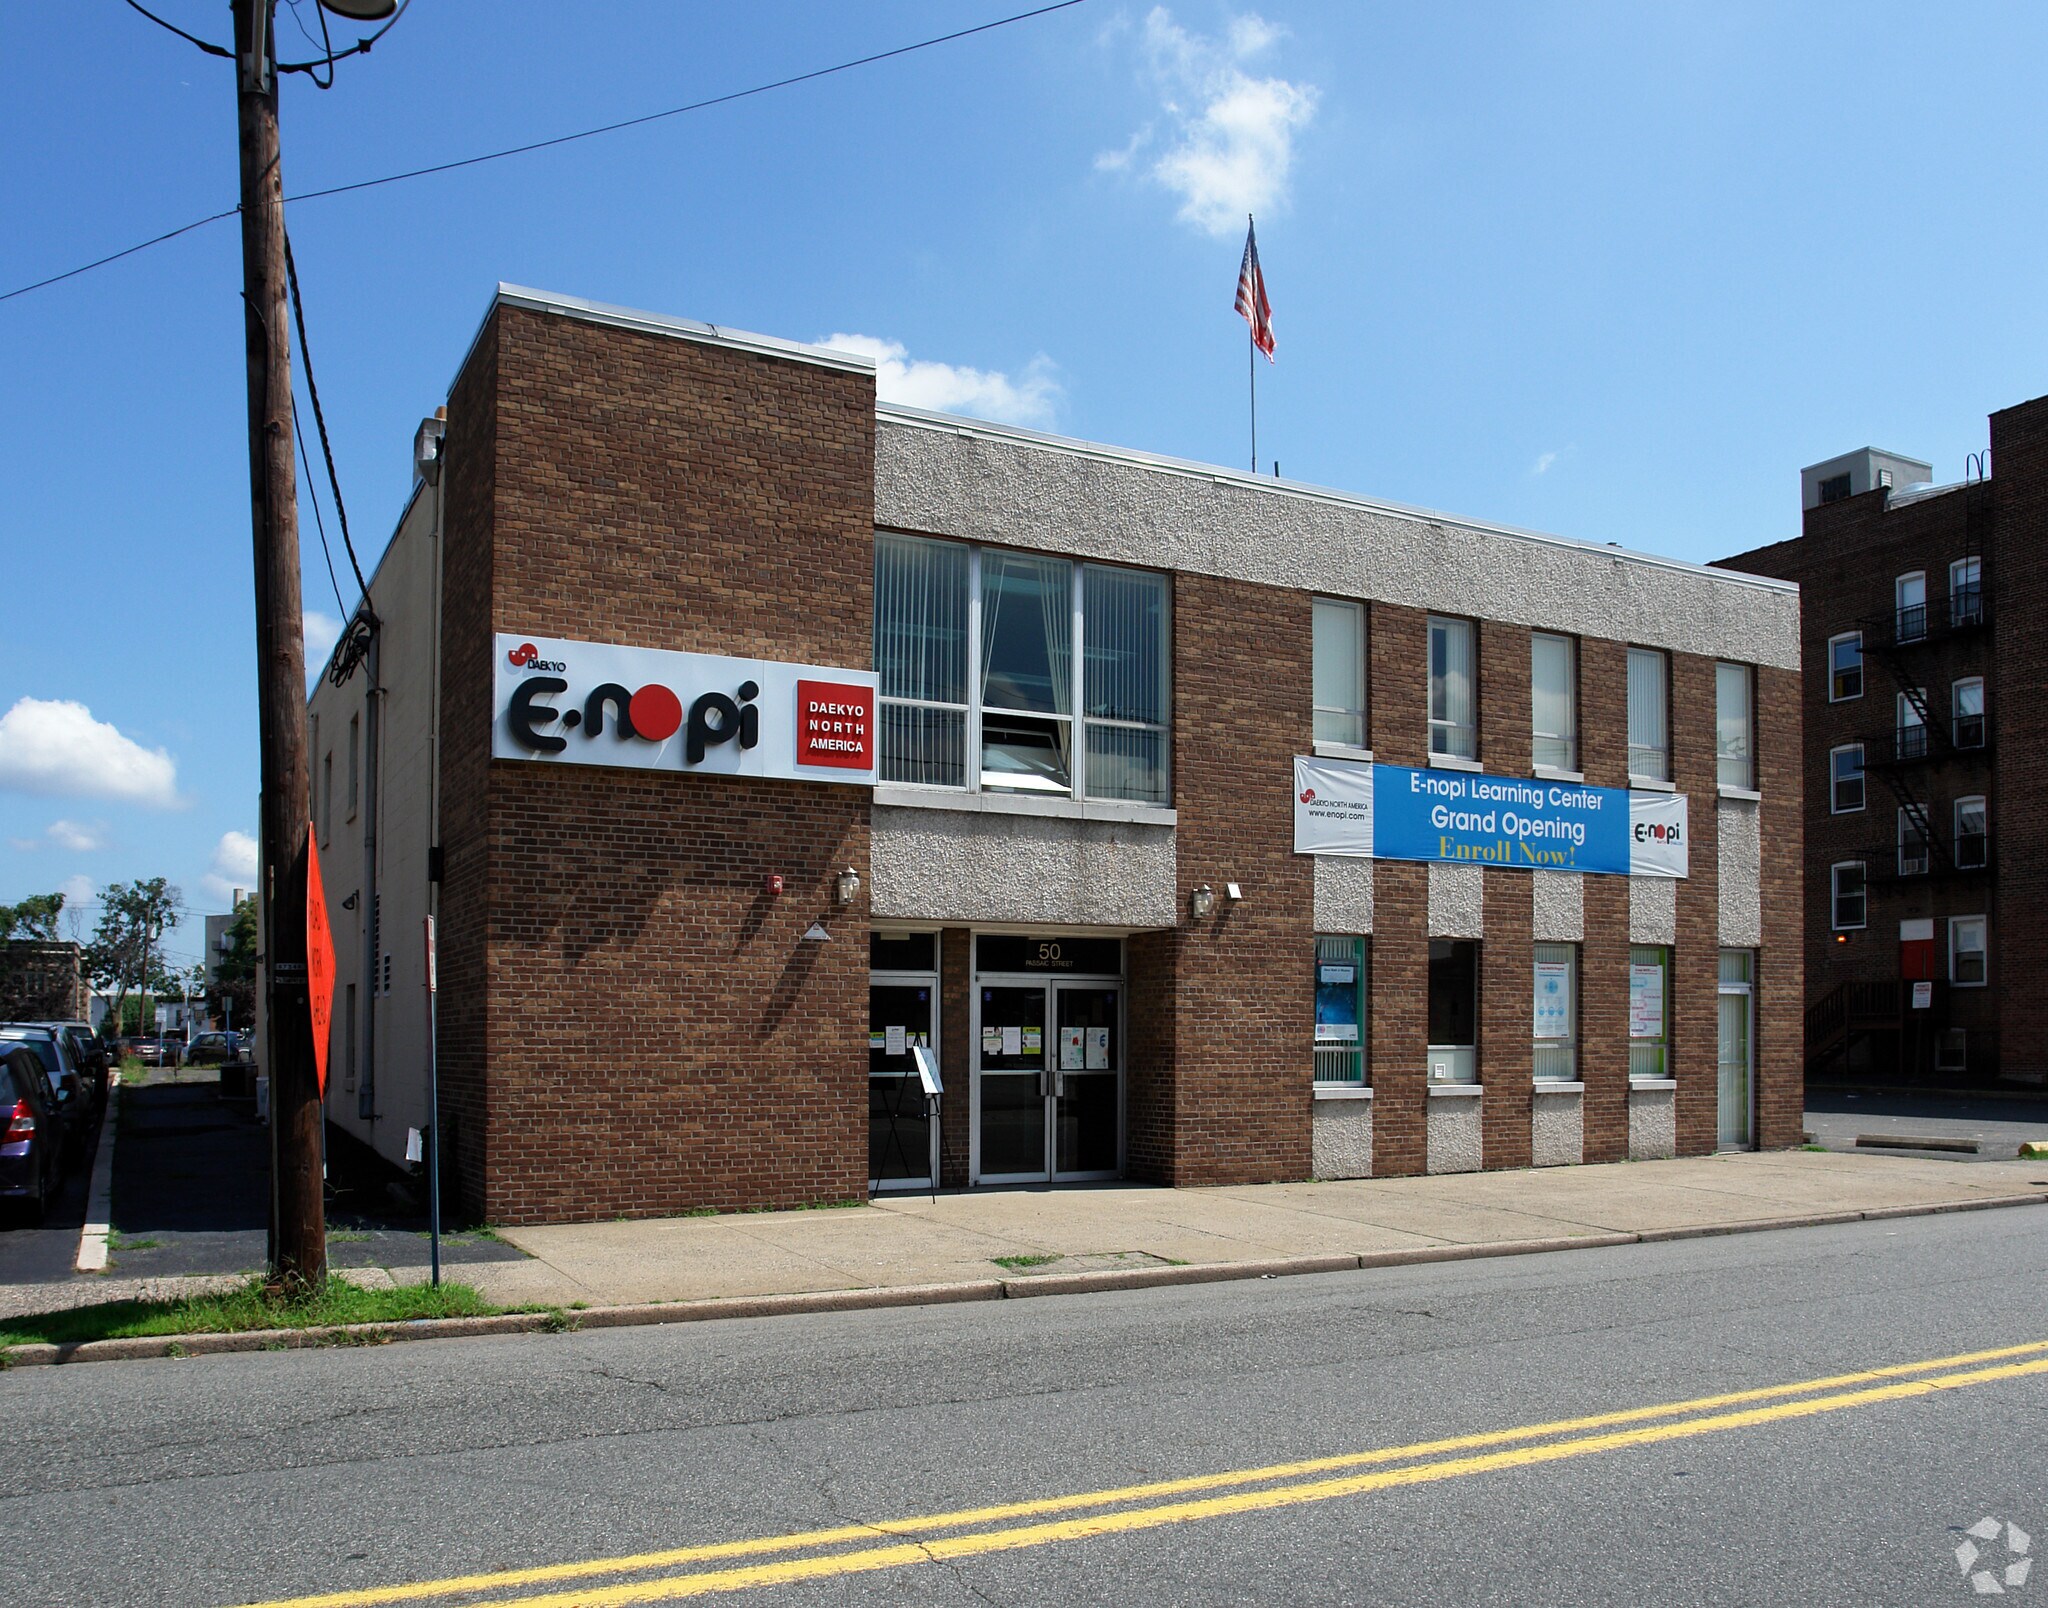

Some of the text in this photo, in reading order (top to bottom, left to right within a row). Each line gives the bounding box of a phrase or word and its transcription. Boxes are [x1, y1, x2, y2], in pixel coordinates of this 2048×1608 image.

[528, 659, 567, 672] DAEKYO
[809, 701, 865, 717] DAEKYO
[809, 719, 865, 735] NORTH
[809, 738, 864, 753] AMERICA
[1410, 772, 1603, 810] E-nopi Learning Center
[1348, 802, 1368, 810] AMERICA
[1309, 810, 1365, 820] www.enopi.com
[1431, 804, 1586, 847] Grand Opening
[1439, 836, 1576, 866] Enroll Now!
[1039, 943, 1061, 960] 50
